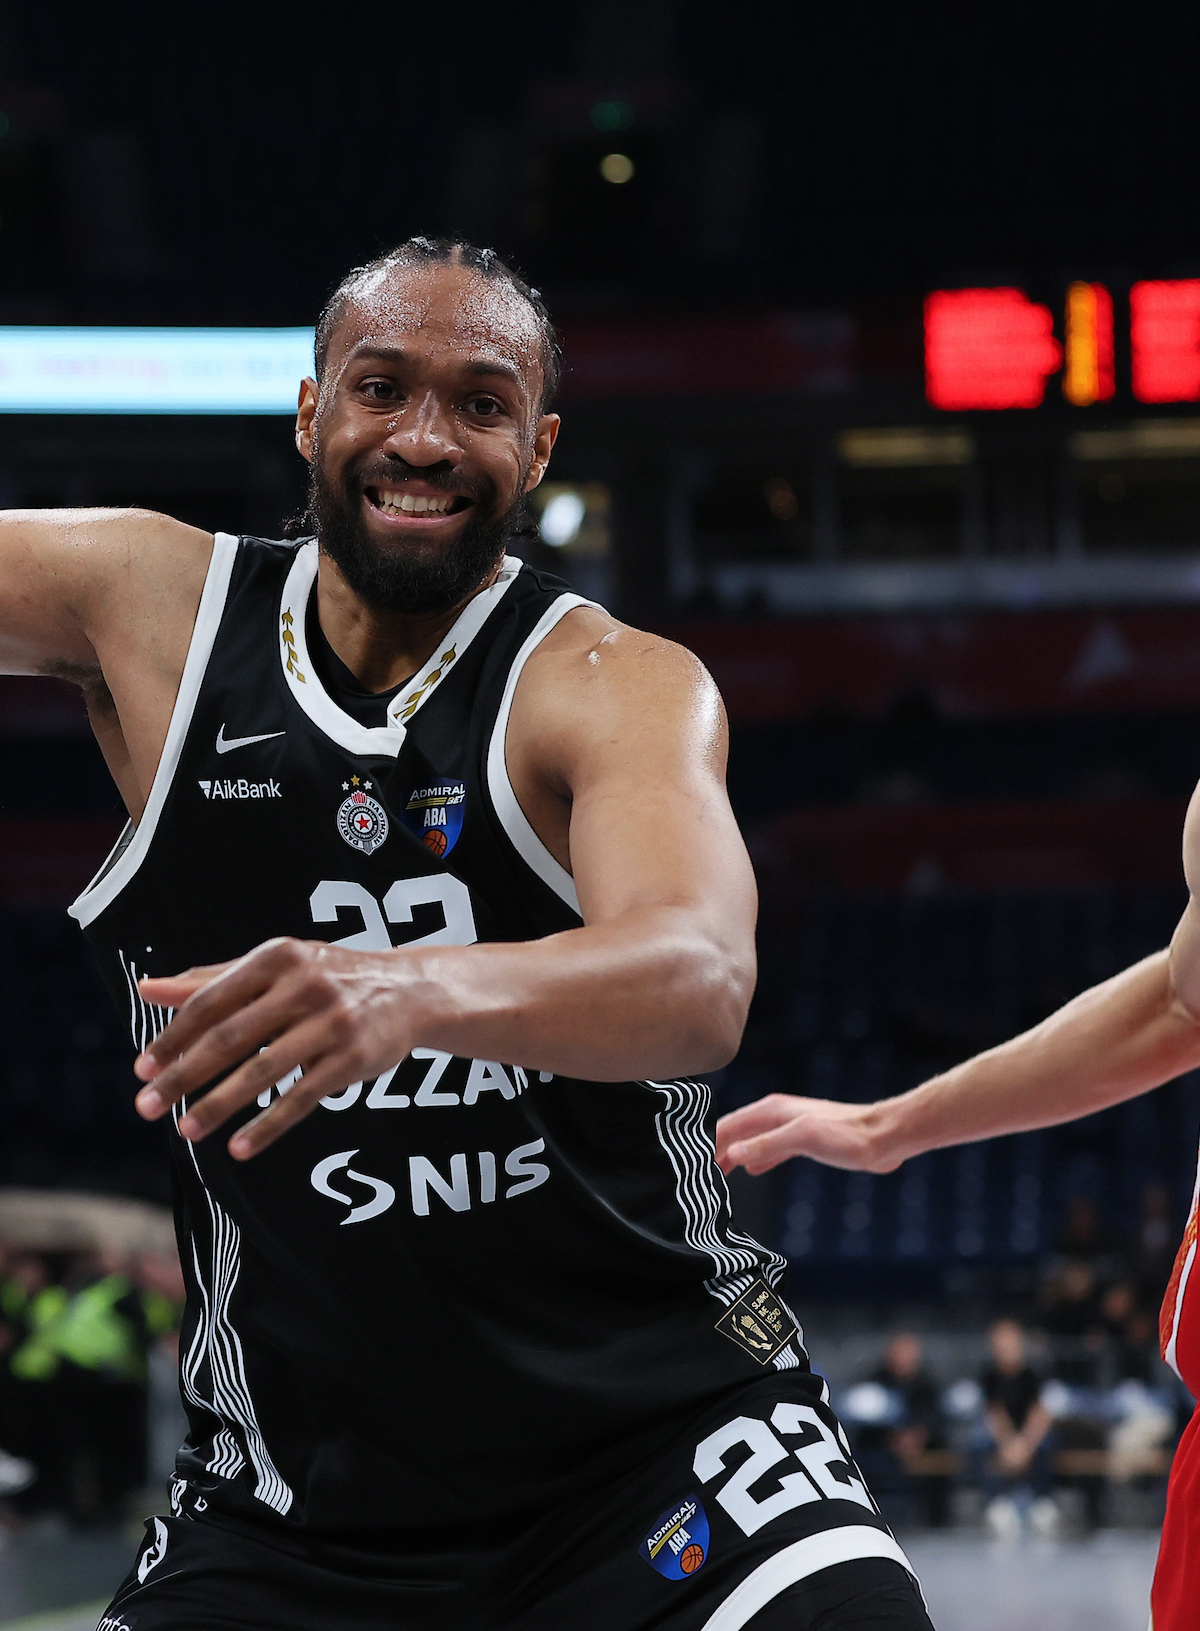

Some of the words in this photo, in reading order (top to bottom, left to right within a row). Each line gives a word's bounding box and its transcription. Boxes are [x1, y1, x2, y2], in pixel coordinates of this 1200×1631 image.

[212, 778, 282, 800] AikBank
[409, 783, 466, 802] ADMIRAL
[423, 807, 447, 827] ABA
[408, 1137, 551, 1217] NIS
[692, 1402, 877, 1538] 22
[646, 1501, 696, 1552] ADMIRAL
[667, 1527, 692, 1556] ABA
